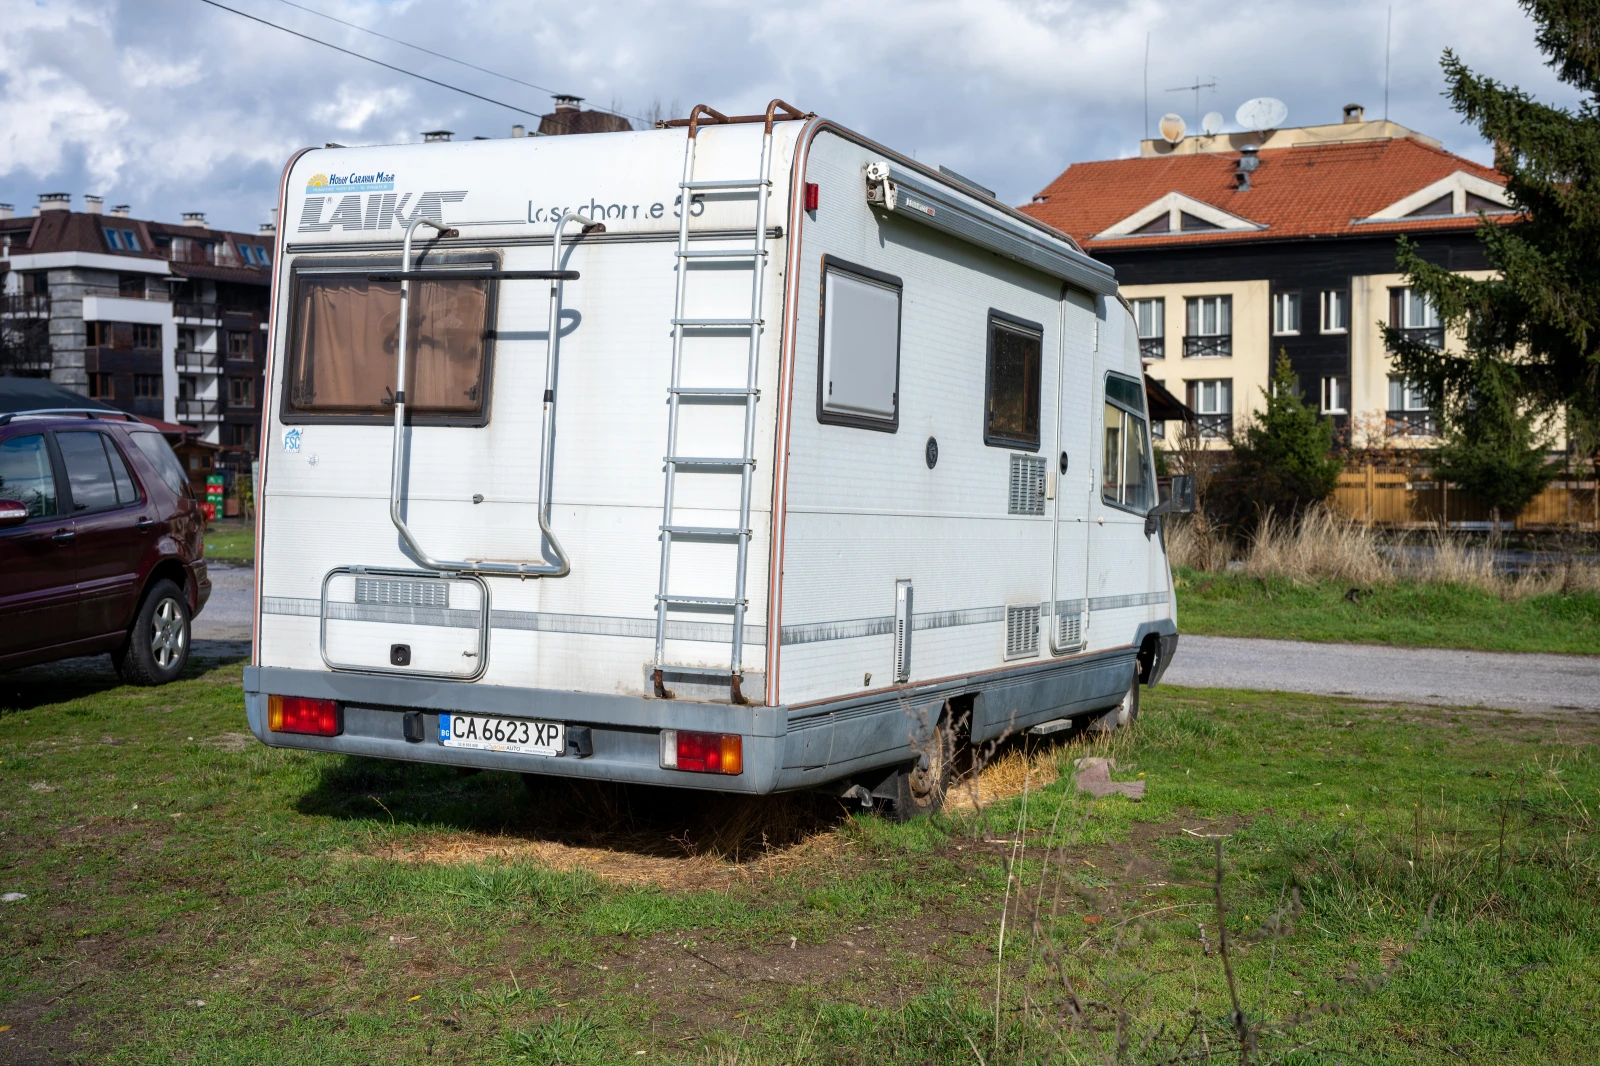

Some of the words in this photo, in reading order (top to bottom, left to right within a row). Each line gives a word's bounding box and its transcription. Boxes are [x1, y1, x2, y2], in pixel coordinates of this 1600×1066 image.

[297, 190, 469, 233] LAIKA
[673, 194, 706, 218] 55
[284, 436, 300, 449] FSC
[441, 729, 450, 737] BG
[453, 716, 478, 740] CA
[482, 719, 530, 744] 6623
[534, 722, 559, 747] XP
